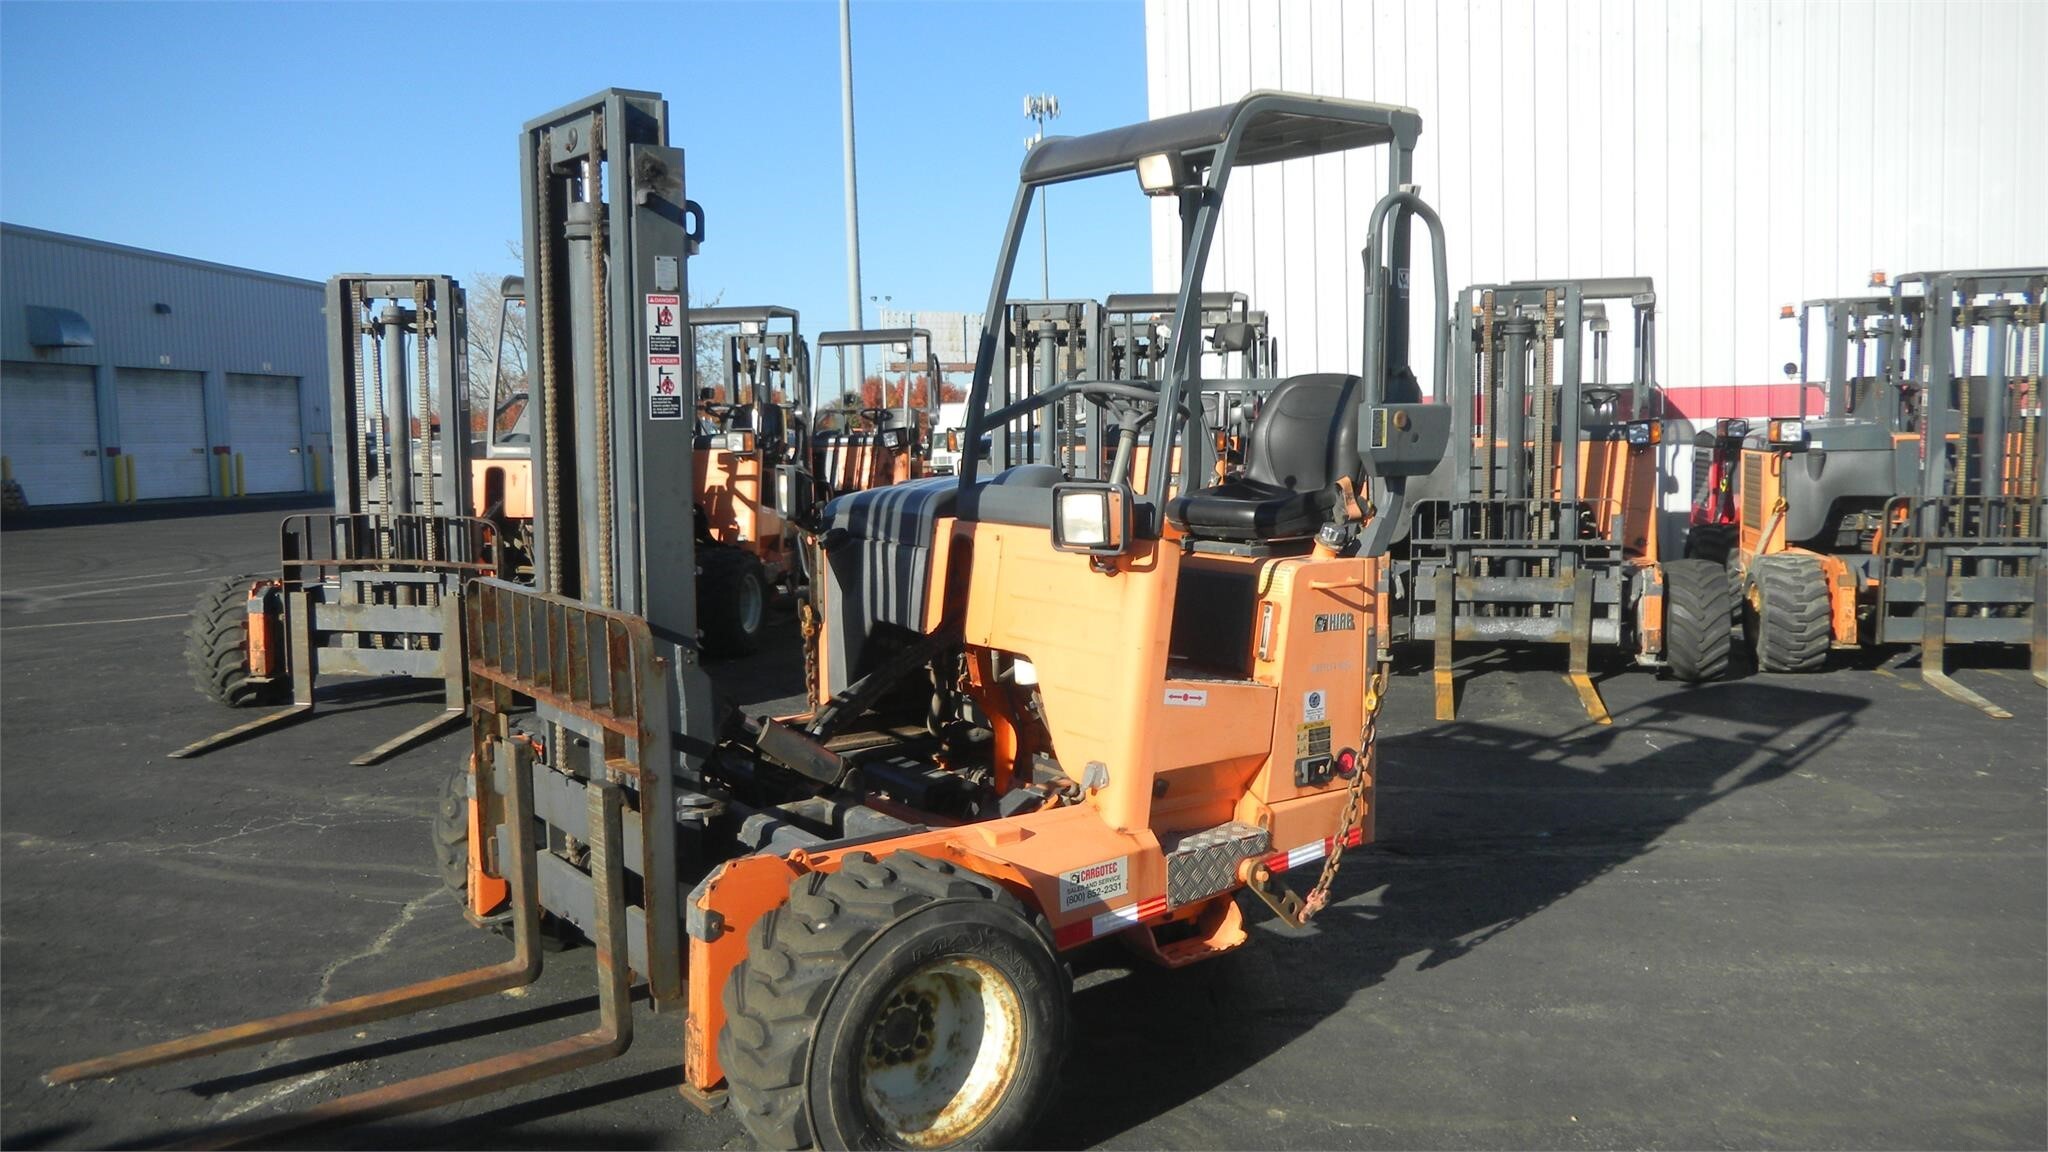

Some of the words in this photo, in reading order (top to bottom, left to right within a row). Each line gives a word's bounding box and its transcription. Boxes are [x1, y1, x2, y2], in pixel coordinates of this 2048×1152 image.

[1327, 613, 1355, 630] HIAB
[1081, 862, 1118, 881] CARGOTEC
[1085, 881, 1097, 889] AND
[1098, 875, 1120, 885] SERVICE
[1066, 891, 1085, 906] (800)
